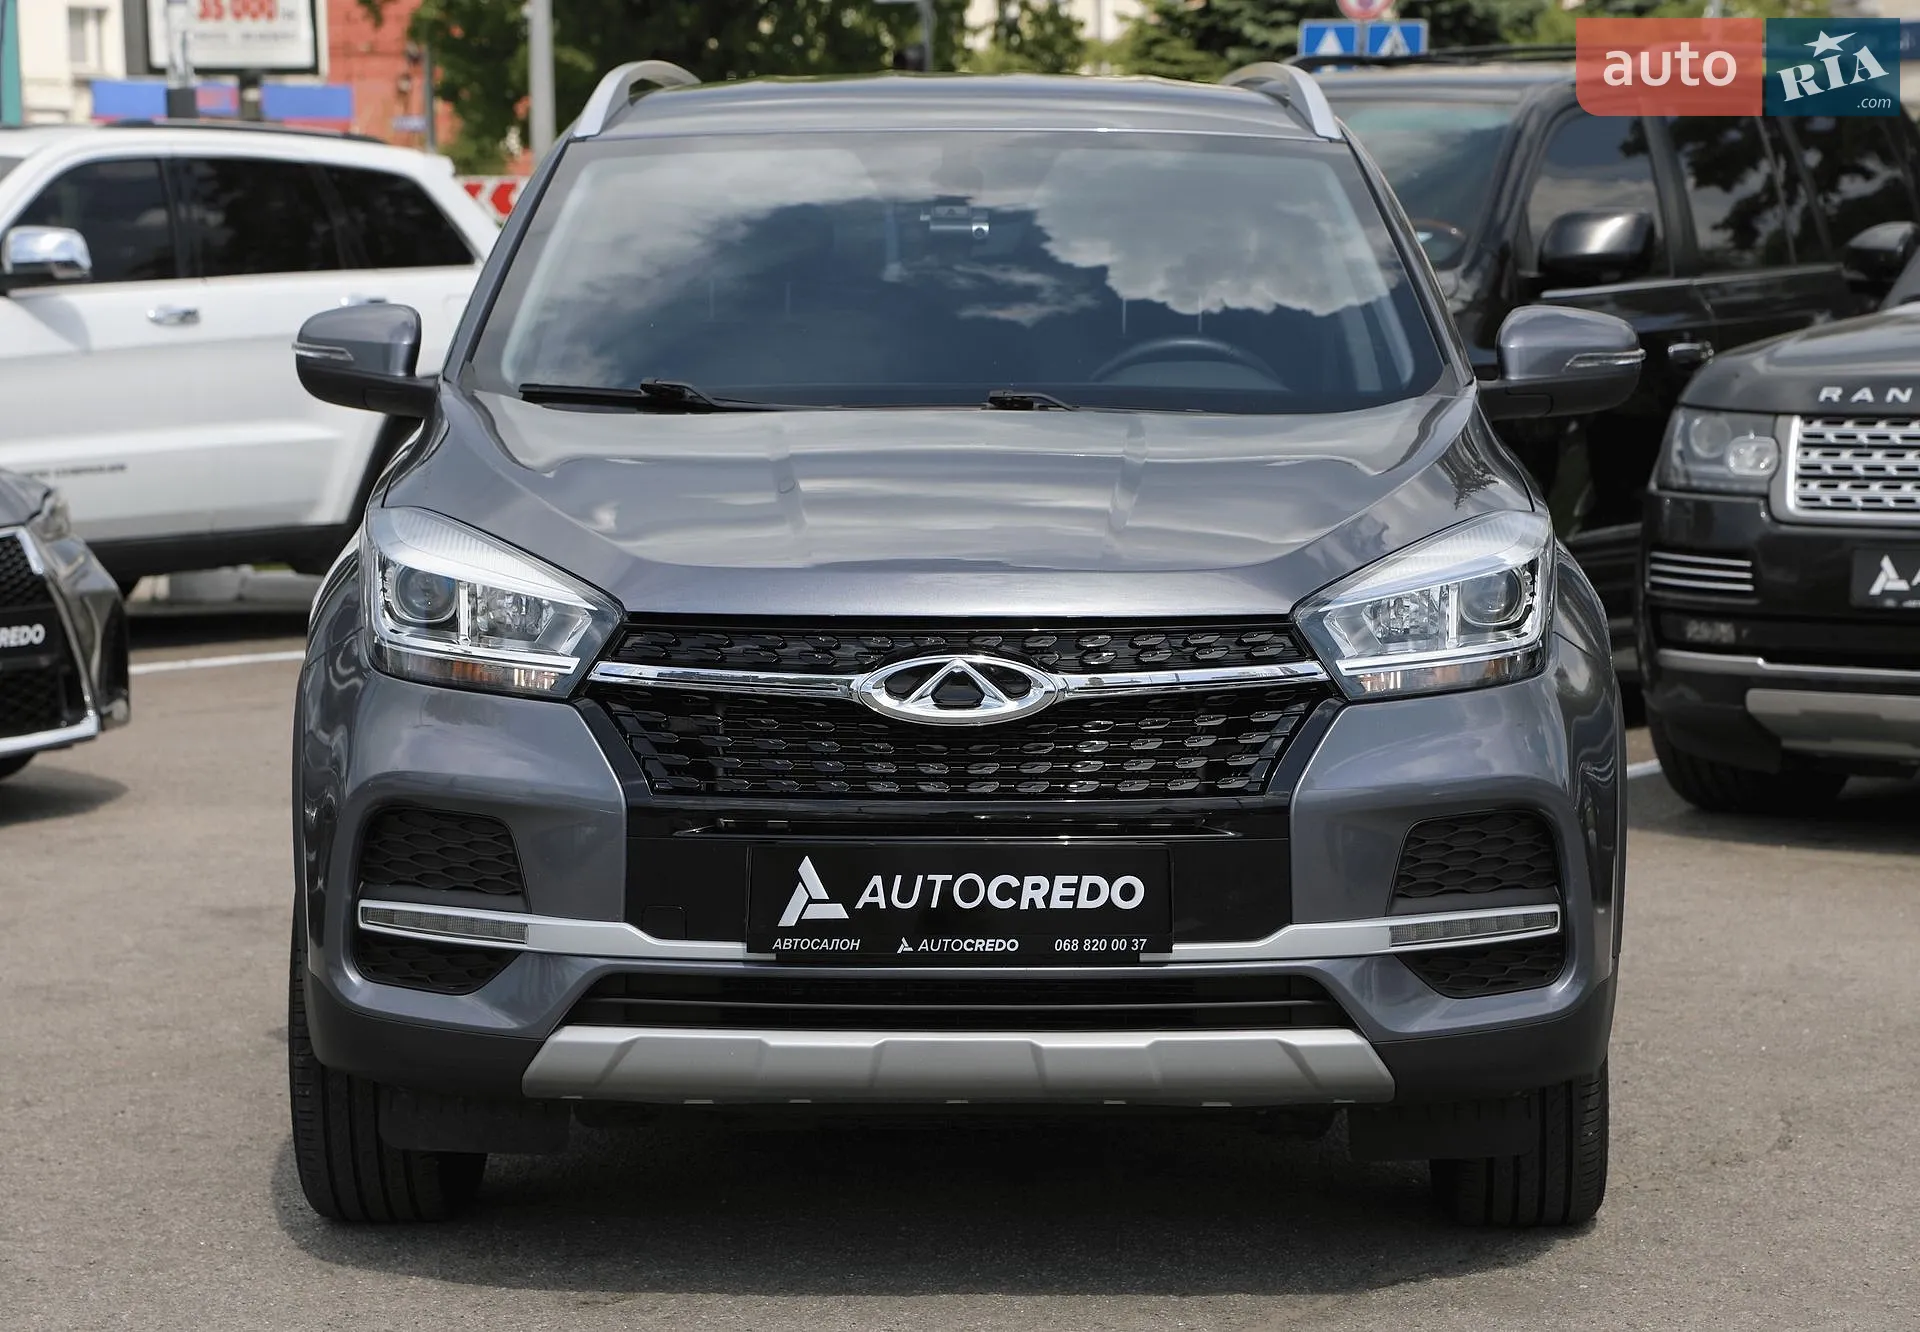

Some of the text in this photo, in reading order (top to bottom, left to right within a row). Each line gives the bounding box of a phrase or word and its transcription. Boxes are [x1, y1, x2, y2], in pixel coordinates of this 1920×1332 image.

[1817, 386, 1913, 403] RAN
[855, 873, 1145, 910] AUTOCREDO
[772, 938, 860, 951] АВТОСАЛОН
[917, 938, 1019, 952] AUTOCREDO
[1054, 938, 1147, 951] 068 820 00 37
